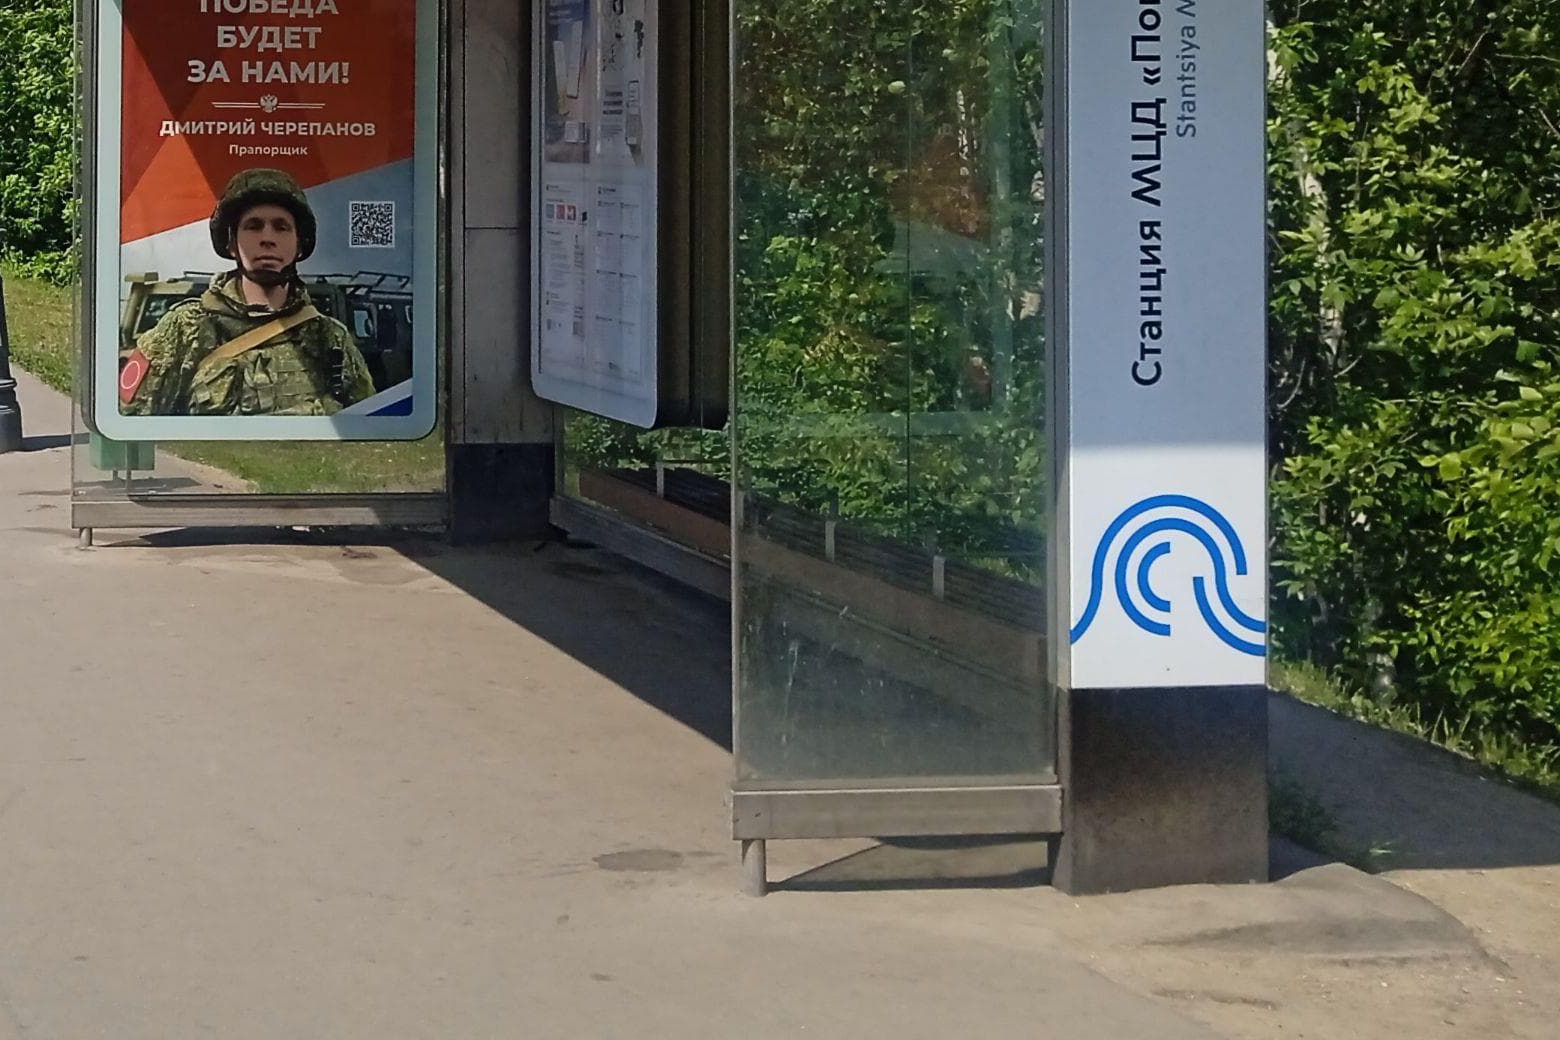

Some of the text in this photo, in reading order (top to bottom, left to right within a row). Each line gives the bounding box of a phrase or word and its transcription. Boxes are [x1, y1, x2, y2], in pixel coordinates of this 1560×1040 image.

[216, 26, 322, 52] БУДЕТ
[187, 60, 350, 84] ЗА НАМИ!
[1176, 25, 1200, 138] Stantsiya
[160, 118, 376, 138] ДМИТРИЙ ЧЕРЕПАНОВ
[229, 144, 308, 157] Прапорщик
[1131, 98, 1167, 206] МЦД
[1132, 218, 1166, 386] Станция
